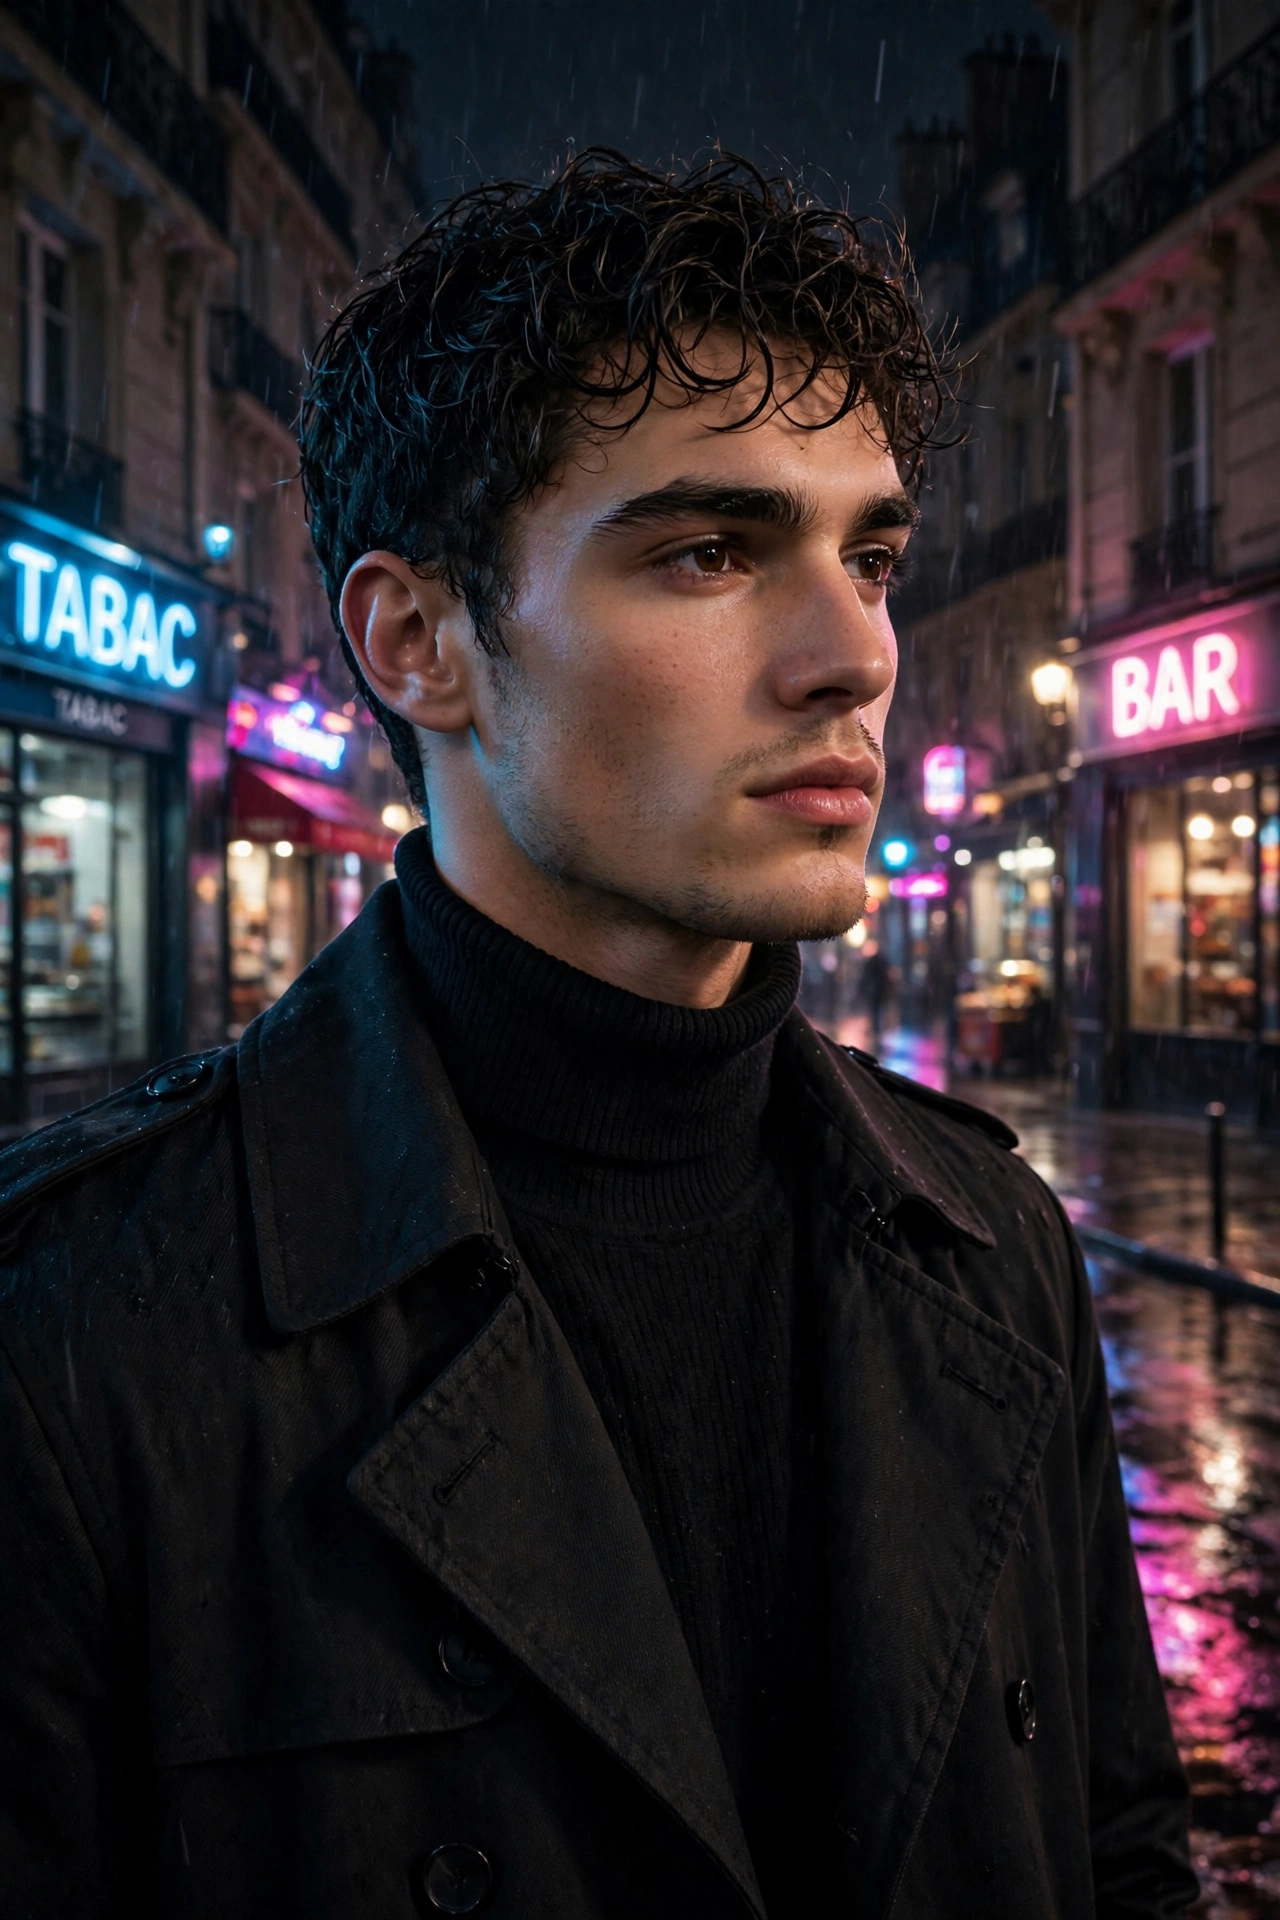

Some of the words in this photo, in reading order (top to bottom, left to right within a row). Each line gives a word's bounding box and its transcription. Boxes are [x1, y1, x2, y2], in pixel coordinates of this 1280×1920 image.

[7, 542, 197, 688] TABAC
[53, 687, 128, 736] TABAC
[1111, 632, 1240, 738] BAR
